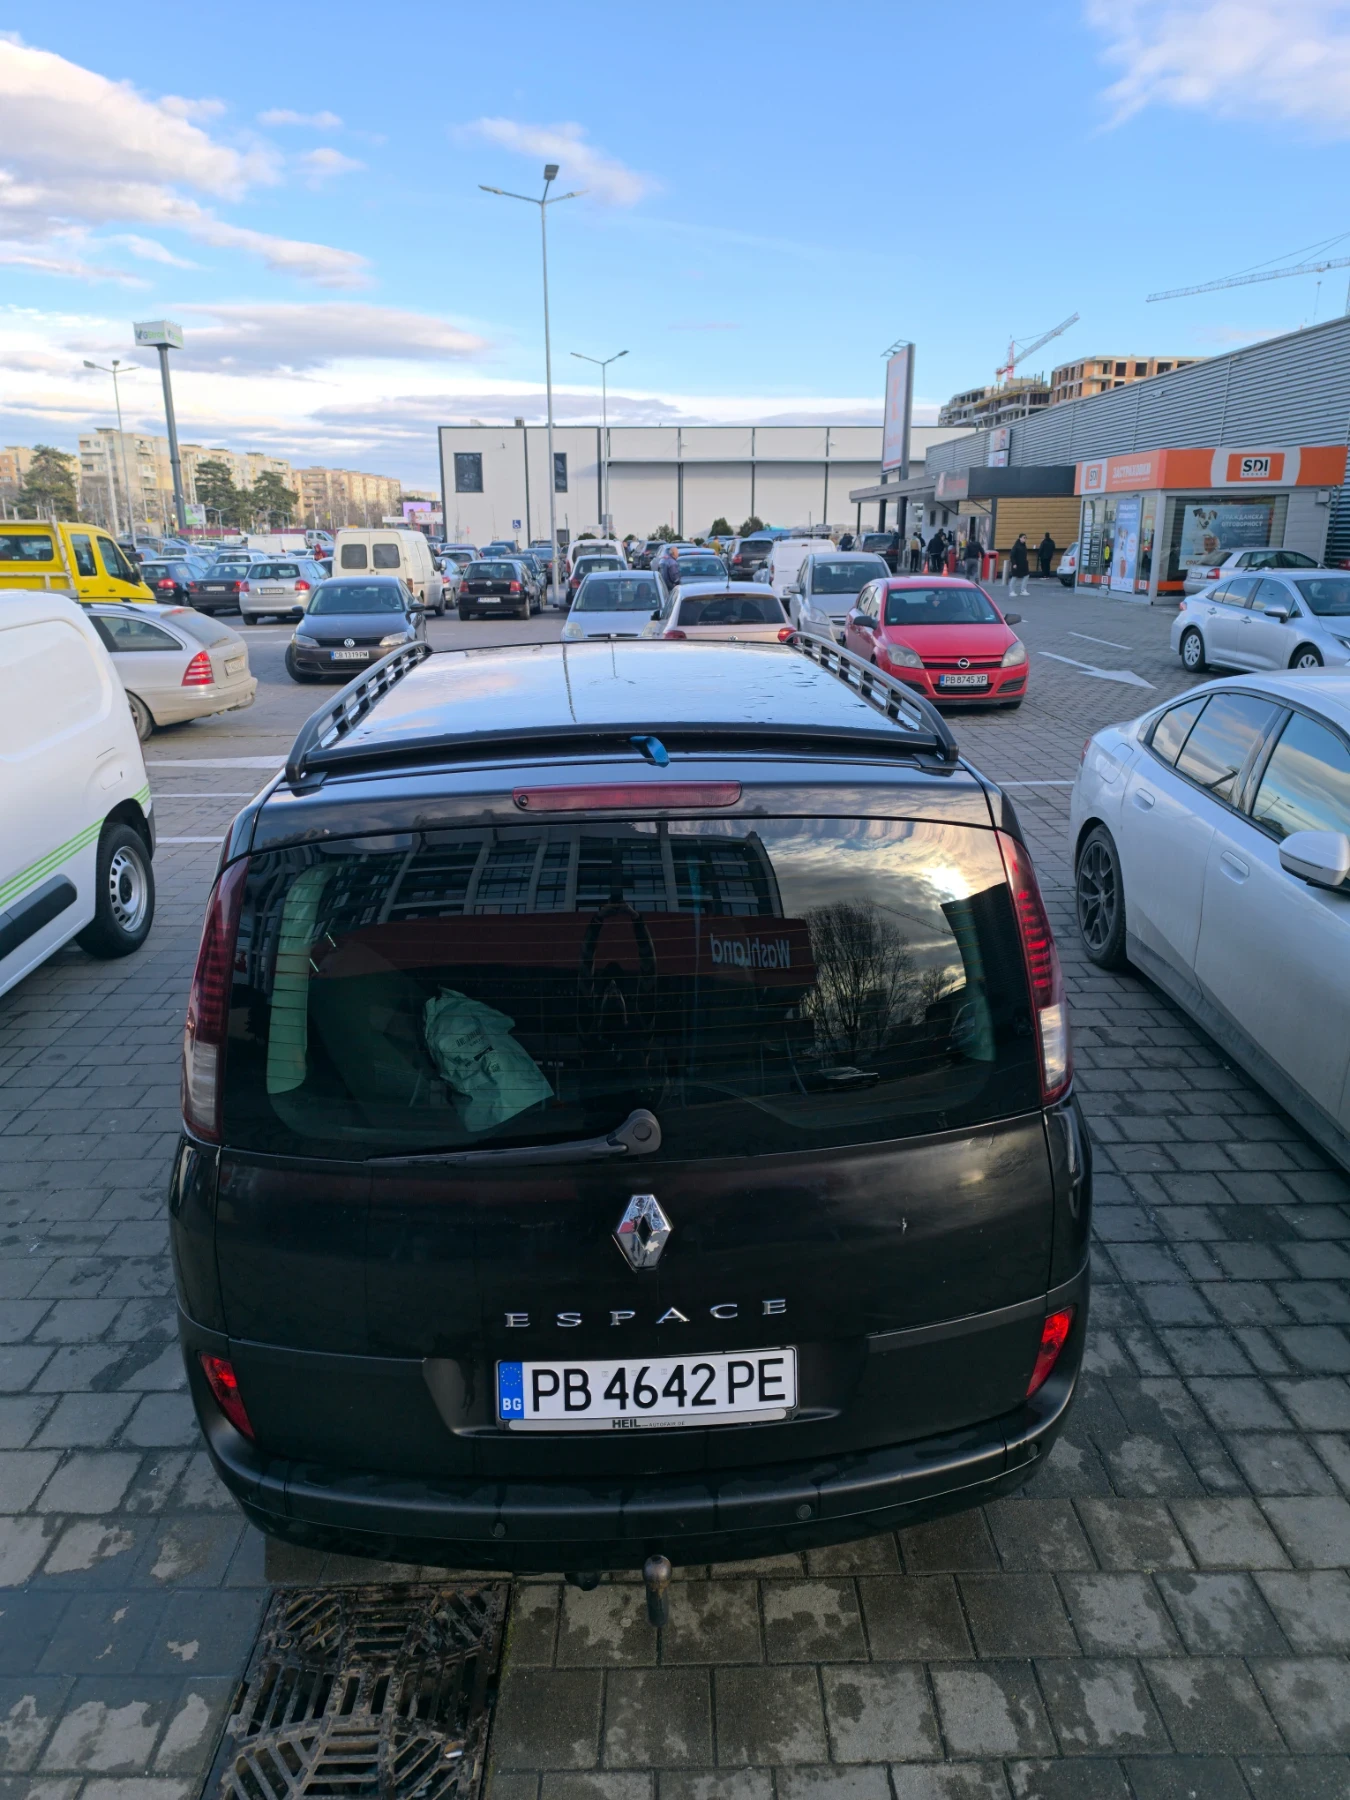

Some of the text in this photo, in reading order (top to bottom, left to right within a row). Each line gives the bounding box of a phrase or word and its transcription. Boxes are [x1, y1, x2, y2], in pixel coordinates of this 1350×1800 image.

[1242, 459, 1268, 472] SDI
[945, 675, 987, 684] PB 8745 XP
[504, 1299, 787, 1328] ESPACE
[532, 1357, 786, 1412] PB 4642 PE
[502, 1398, 522, 1411] BG
[612, 1419, 641, 1428] HEIL
